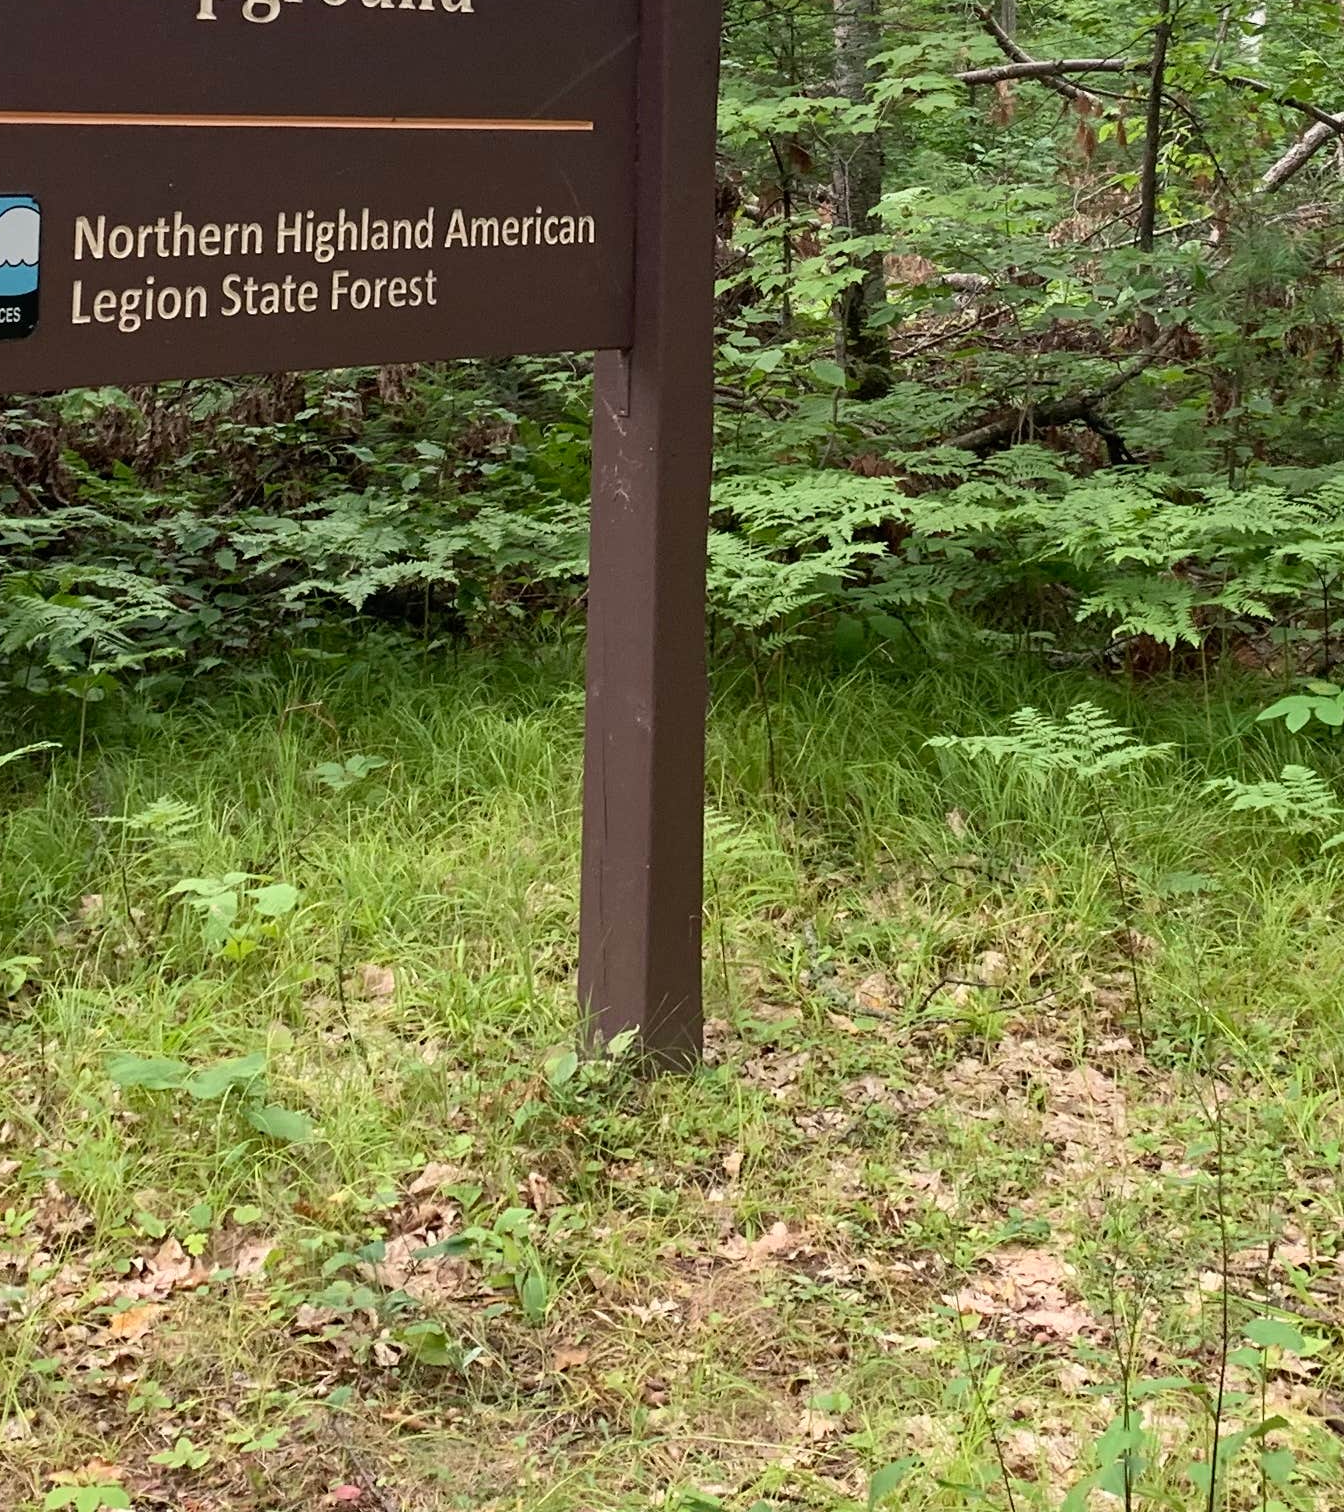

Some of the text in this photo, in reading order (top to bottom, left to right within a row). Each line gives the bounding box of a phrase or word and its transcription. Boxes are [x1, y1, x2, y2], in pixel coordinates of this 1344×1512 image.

[74, 206, 596, 262] Northern Highland American
[70, 269, 438, 333] Legion State Forest
